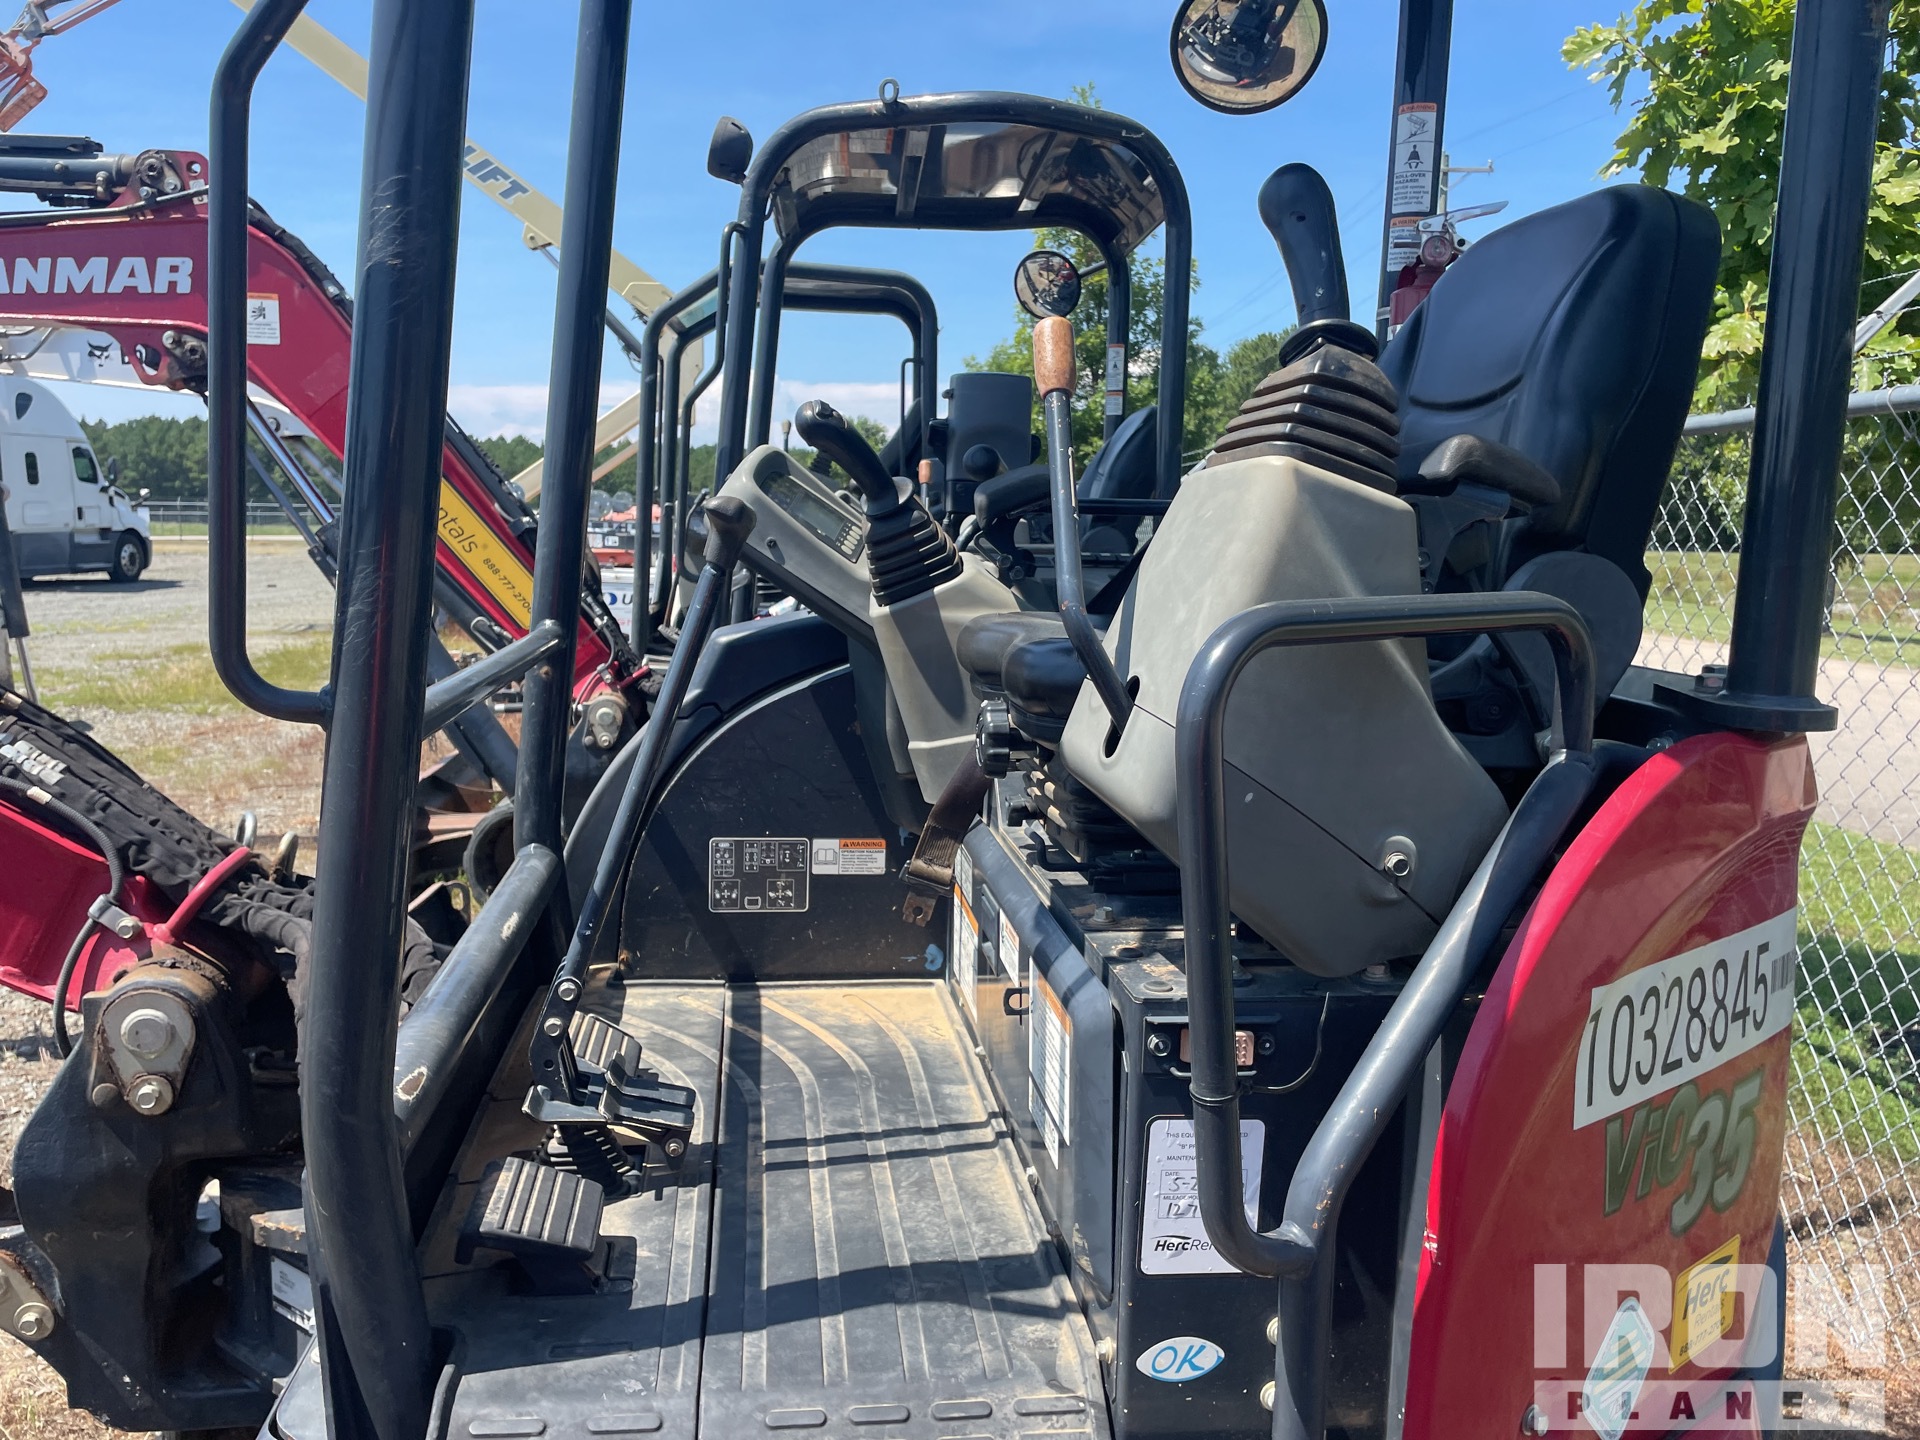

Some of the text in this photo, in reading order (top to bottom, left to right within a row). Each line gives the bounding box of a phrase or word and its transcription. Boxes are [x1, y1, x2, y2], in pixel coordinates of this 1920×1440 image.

[0, 256, 193, 295] NMAR
[1586, 941, 1769, 1108] 10328845
[1682, 1268, 1730, 1320] Herc
[1151, 1344, 1206, 1374] OK
